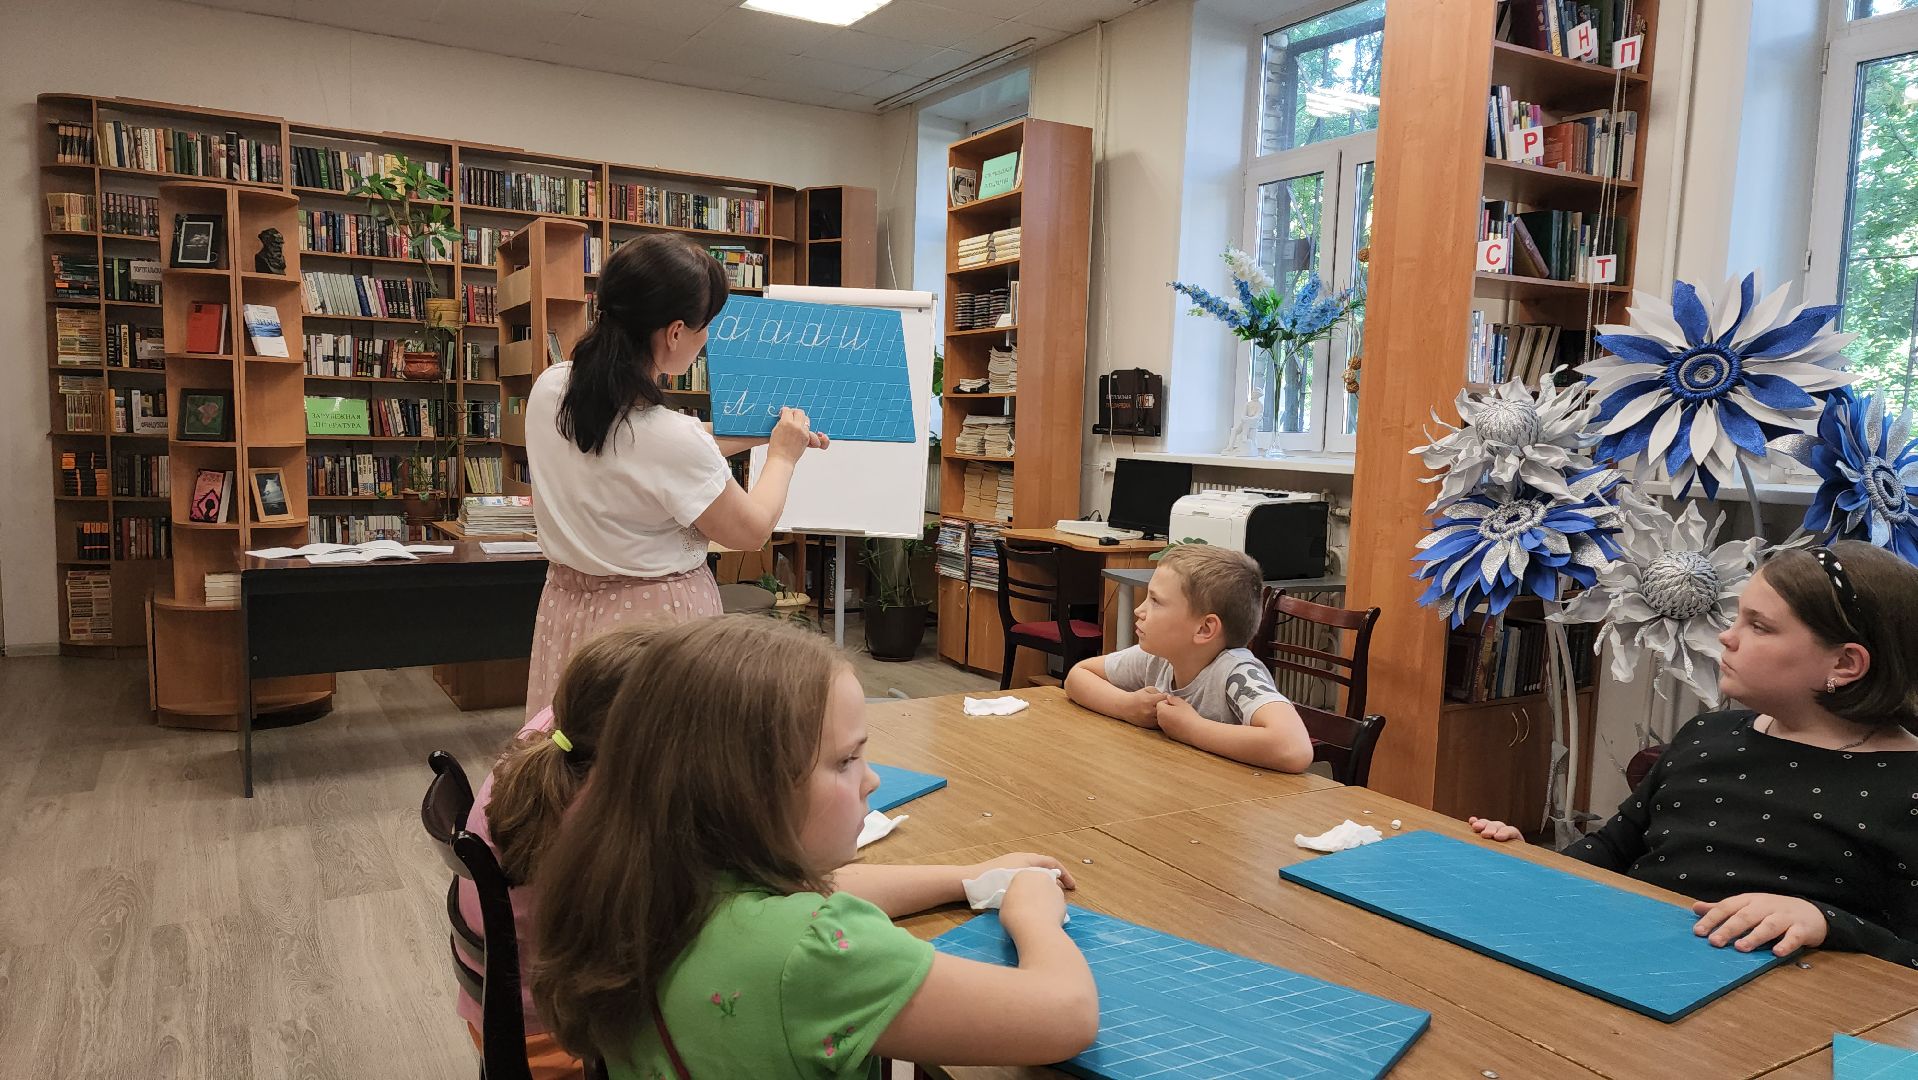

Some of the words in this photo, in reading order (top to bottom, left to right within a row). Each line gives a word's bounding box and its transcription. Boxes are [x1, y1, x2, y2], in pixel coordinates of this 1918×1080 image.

[1578, 26, 1590, 50] Н
[1621, 41, 1636, 64] П
[1524, 132, 1538, 154] Р
[1486, 244, 1502, 265] С
[1597, 258, 1612, 279] Т
